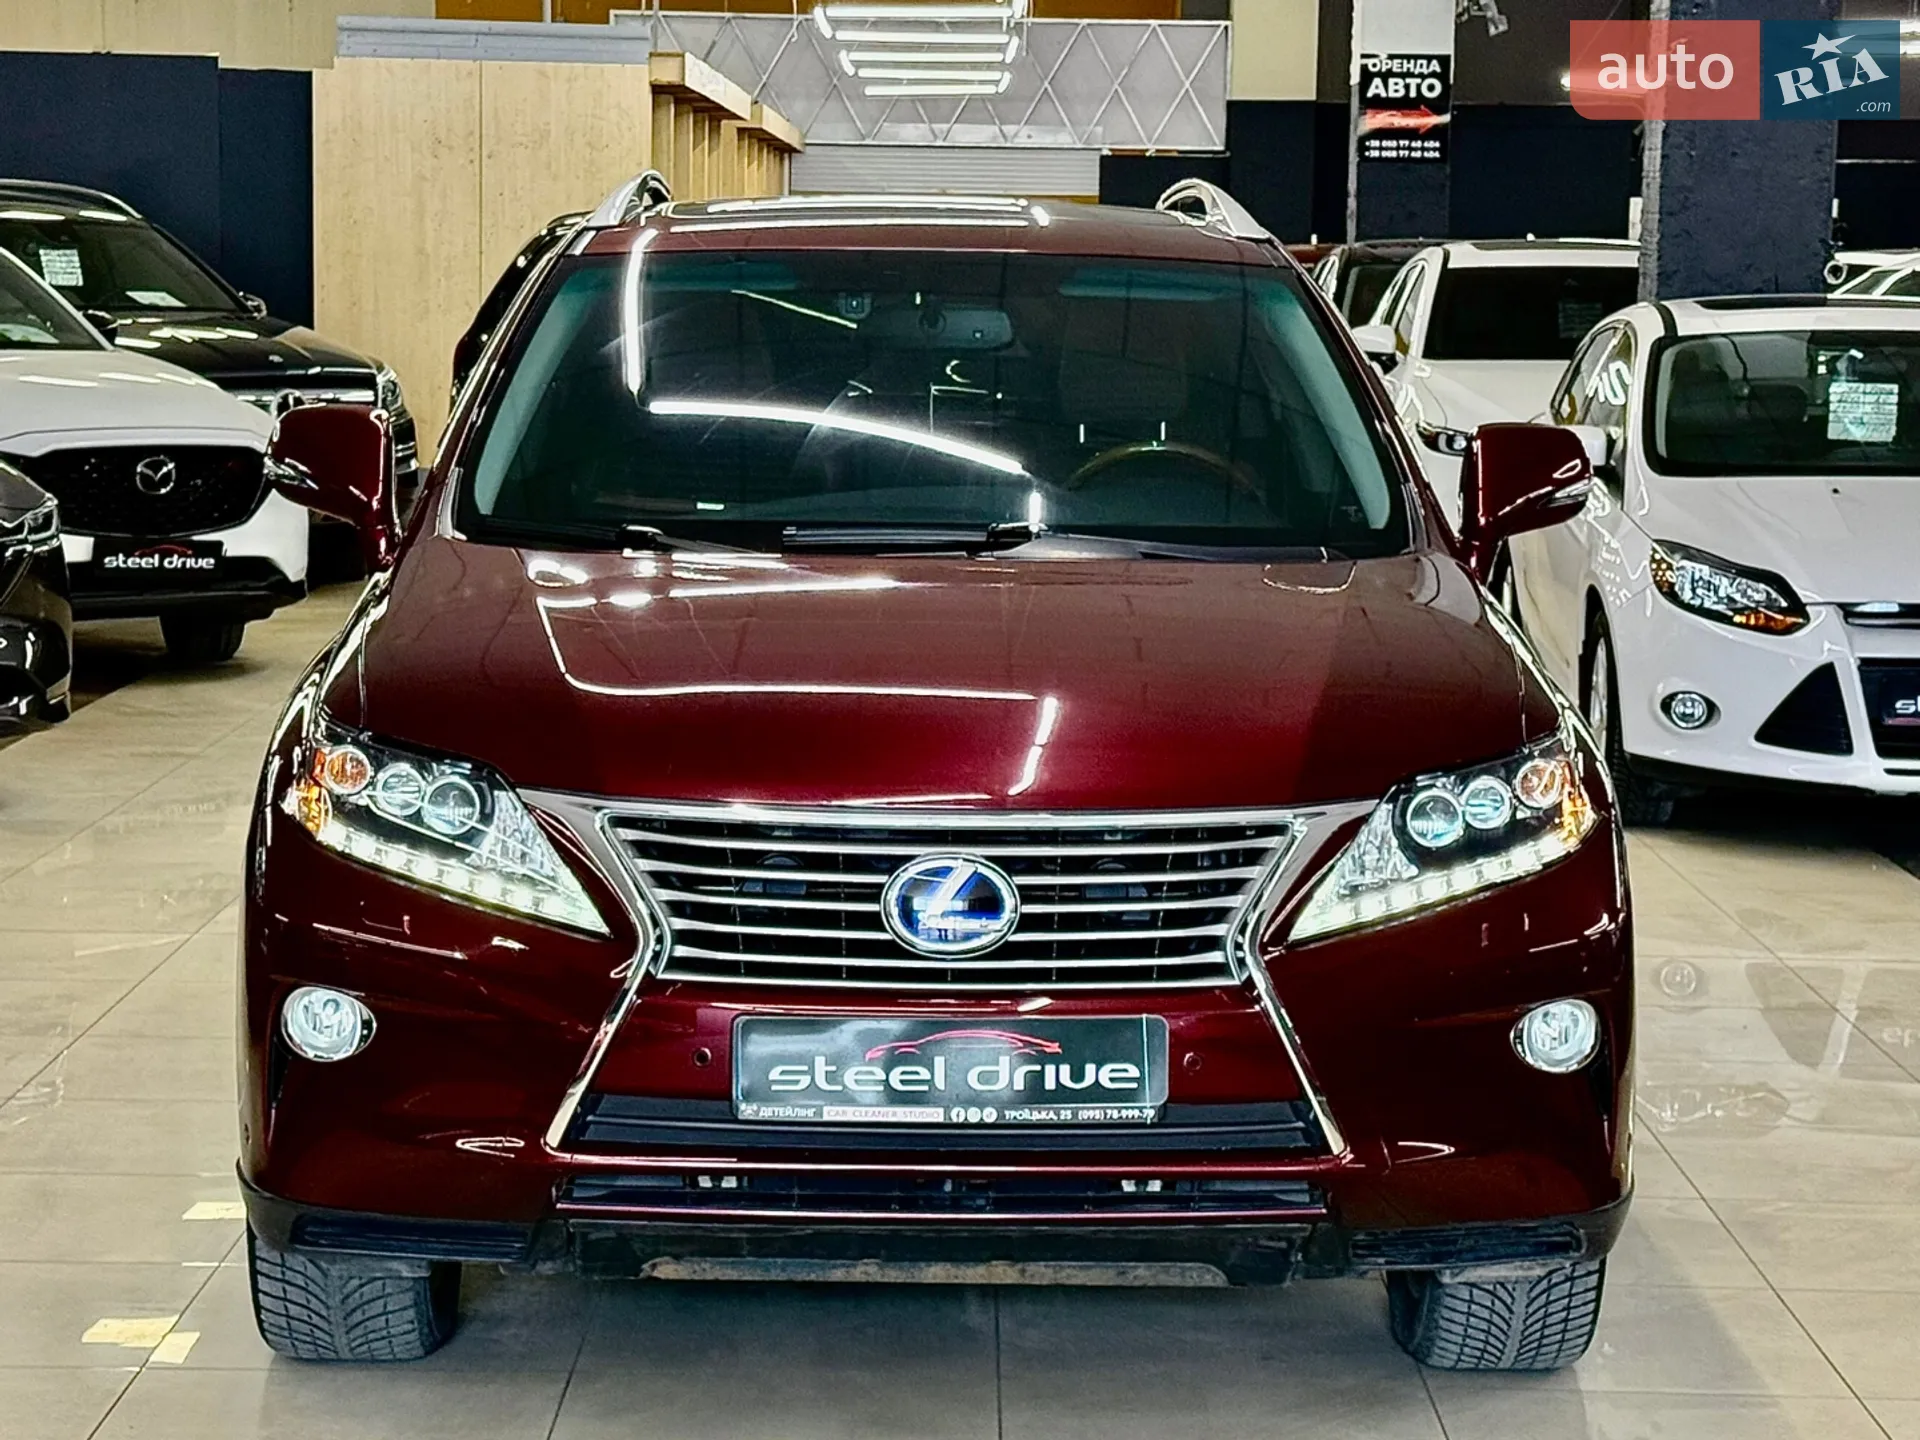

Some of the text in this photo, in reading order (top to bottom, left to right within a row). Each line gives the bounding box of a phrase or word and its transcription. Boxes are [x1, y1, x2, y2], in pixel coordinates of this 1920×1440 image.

[1367, 59, 1442, 75] ОРЕНДА
[1366, 77, 1443, 99] АВТО
[103, 552, 216, 569] steel drive
[768, 1056, 1141, 1092] steel drive
[827, 1109, 941, 1119] CAR CLEANER STUDIO
